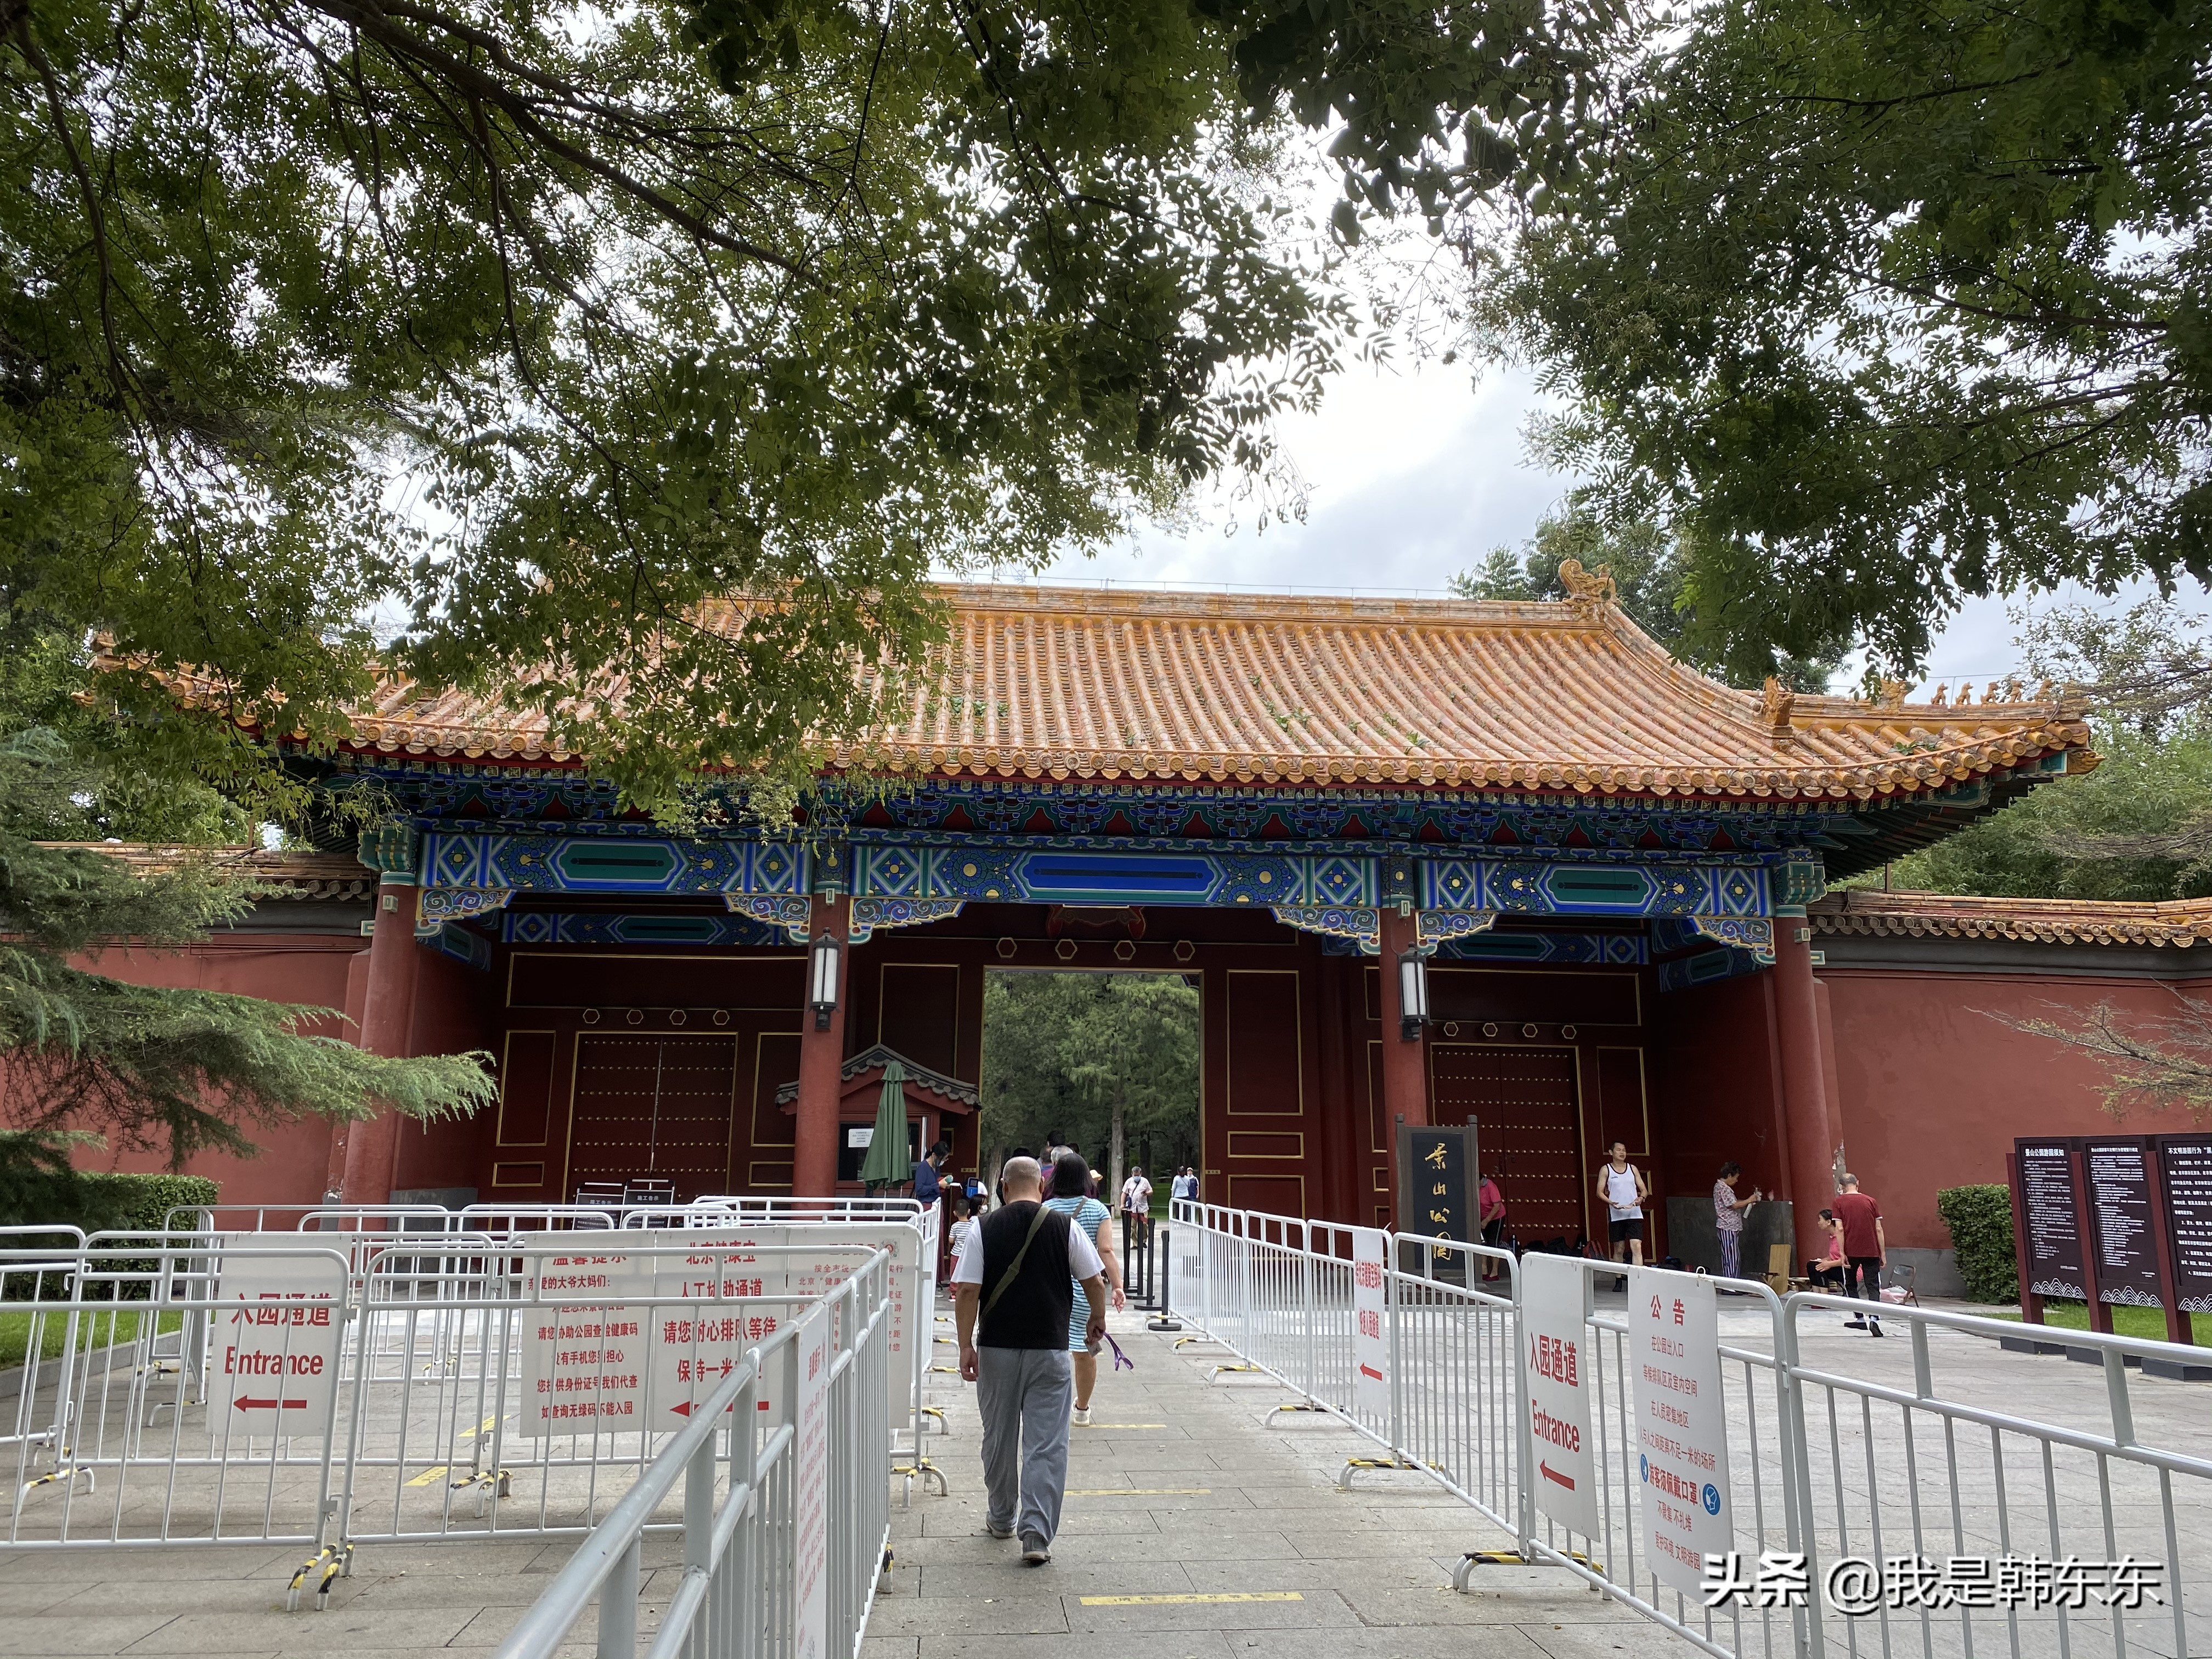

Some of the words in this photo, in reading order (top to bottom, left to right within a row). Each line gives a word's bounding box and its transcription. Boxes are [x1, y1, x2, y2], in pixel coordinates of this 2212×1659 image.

[230, 1293, 333, 1327] 入园通道
[224, 1346, 323, 1375] Entrance
[1530, 1331, 1579, 1387] 入园通道
[1651, 1334, 1684, 1358] 在公园出入口
[1532, 1398, 1580, 1453] Entrance
